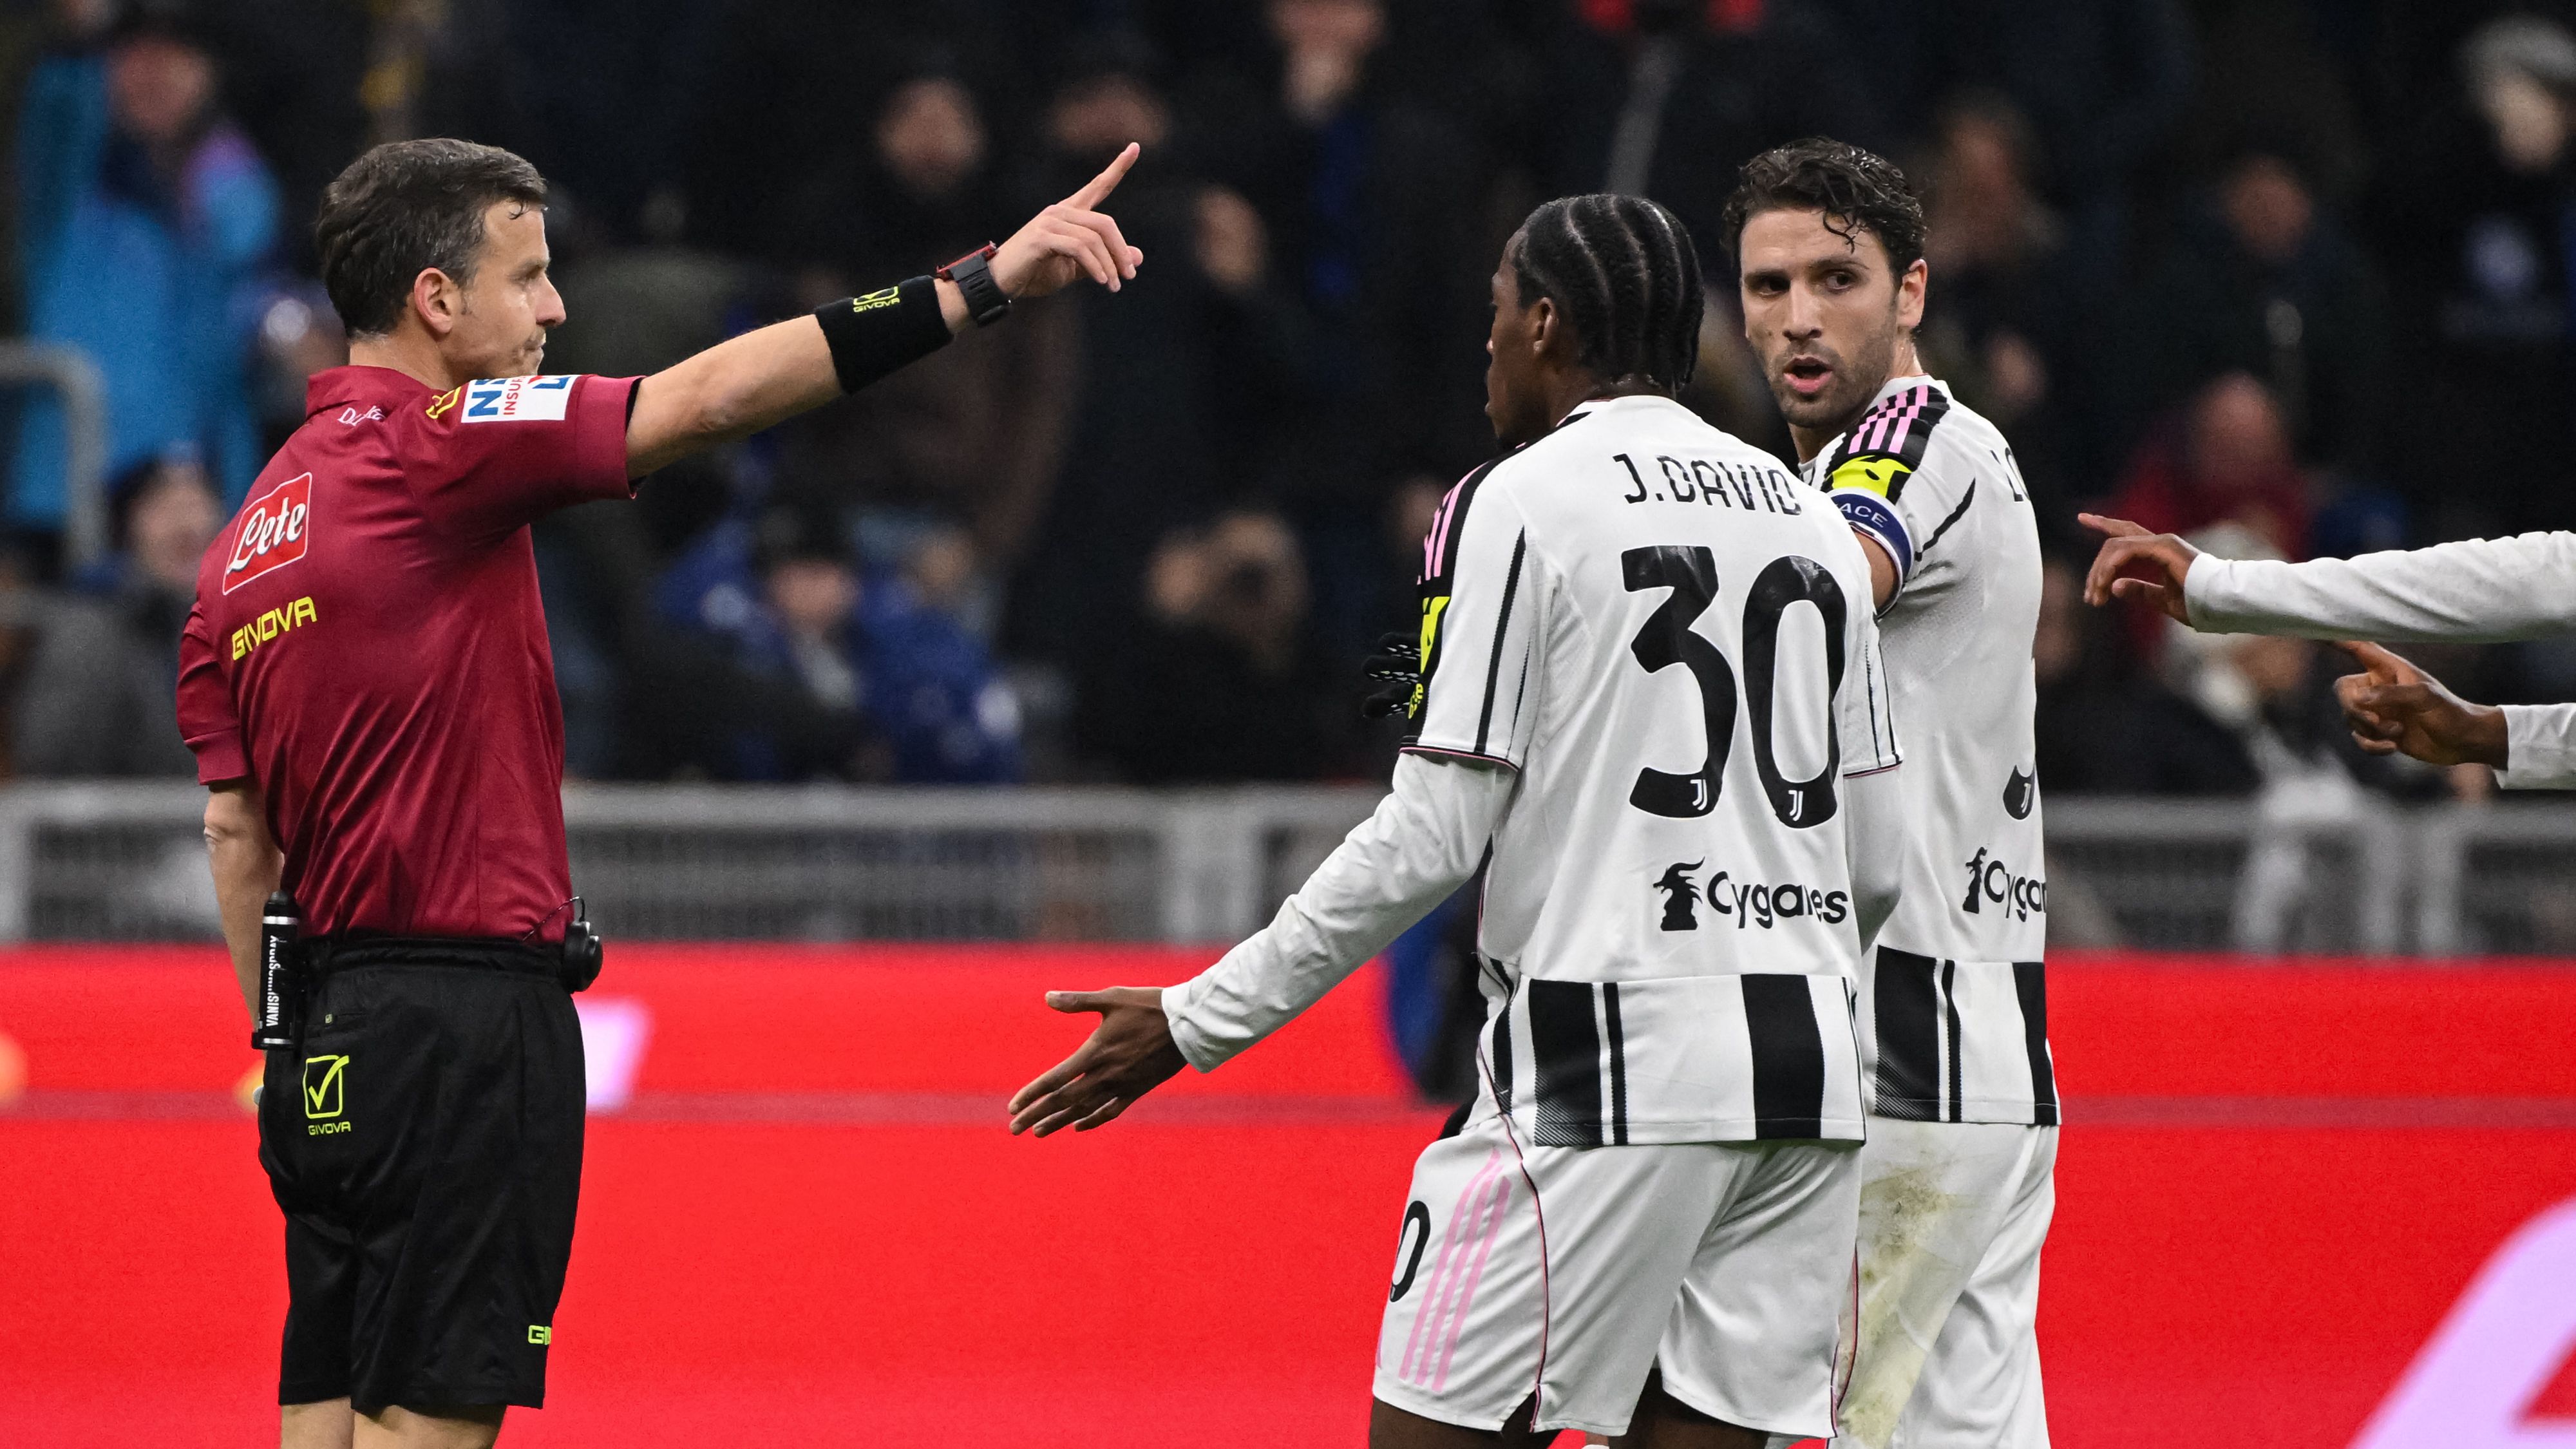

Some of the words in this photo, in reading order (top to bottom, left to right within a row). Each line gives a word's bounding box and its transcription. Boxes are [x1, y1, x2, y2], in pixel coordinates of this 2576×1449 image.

[853, 298, 900, 313] GIVOVA
[226, 497, 306, 575] Lete
[1837, 502, 1888, 528] ACE
[232, 596, 317, 661] GIVOVA
[1621, 545, 1847, 829] 30
[308, 1121, 352, 1136] GIVOVA
